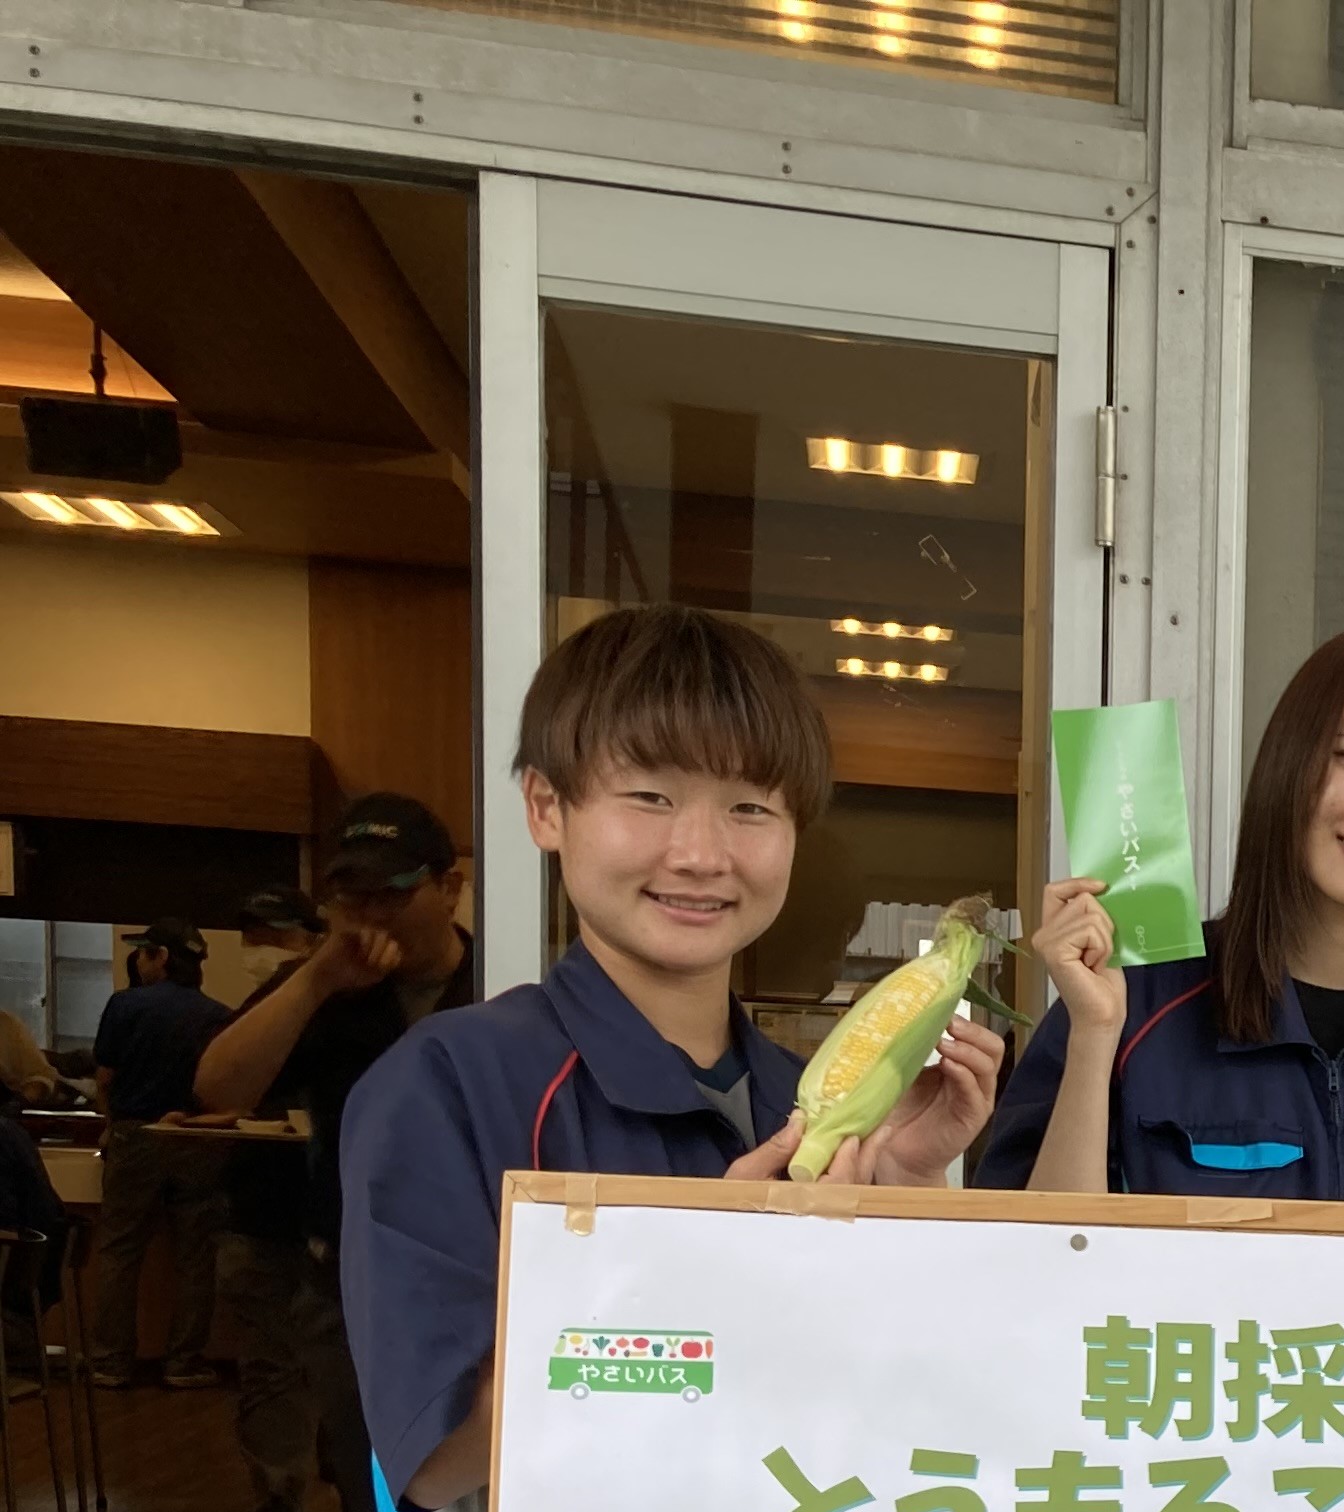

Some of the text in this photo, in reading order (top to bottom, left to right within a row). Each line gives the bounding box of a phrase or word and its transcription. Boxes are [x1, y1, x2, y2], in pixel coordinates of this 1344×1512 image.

[577, 1364, 687, 1385] やさいバス
